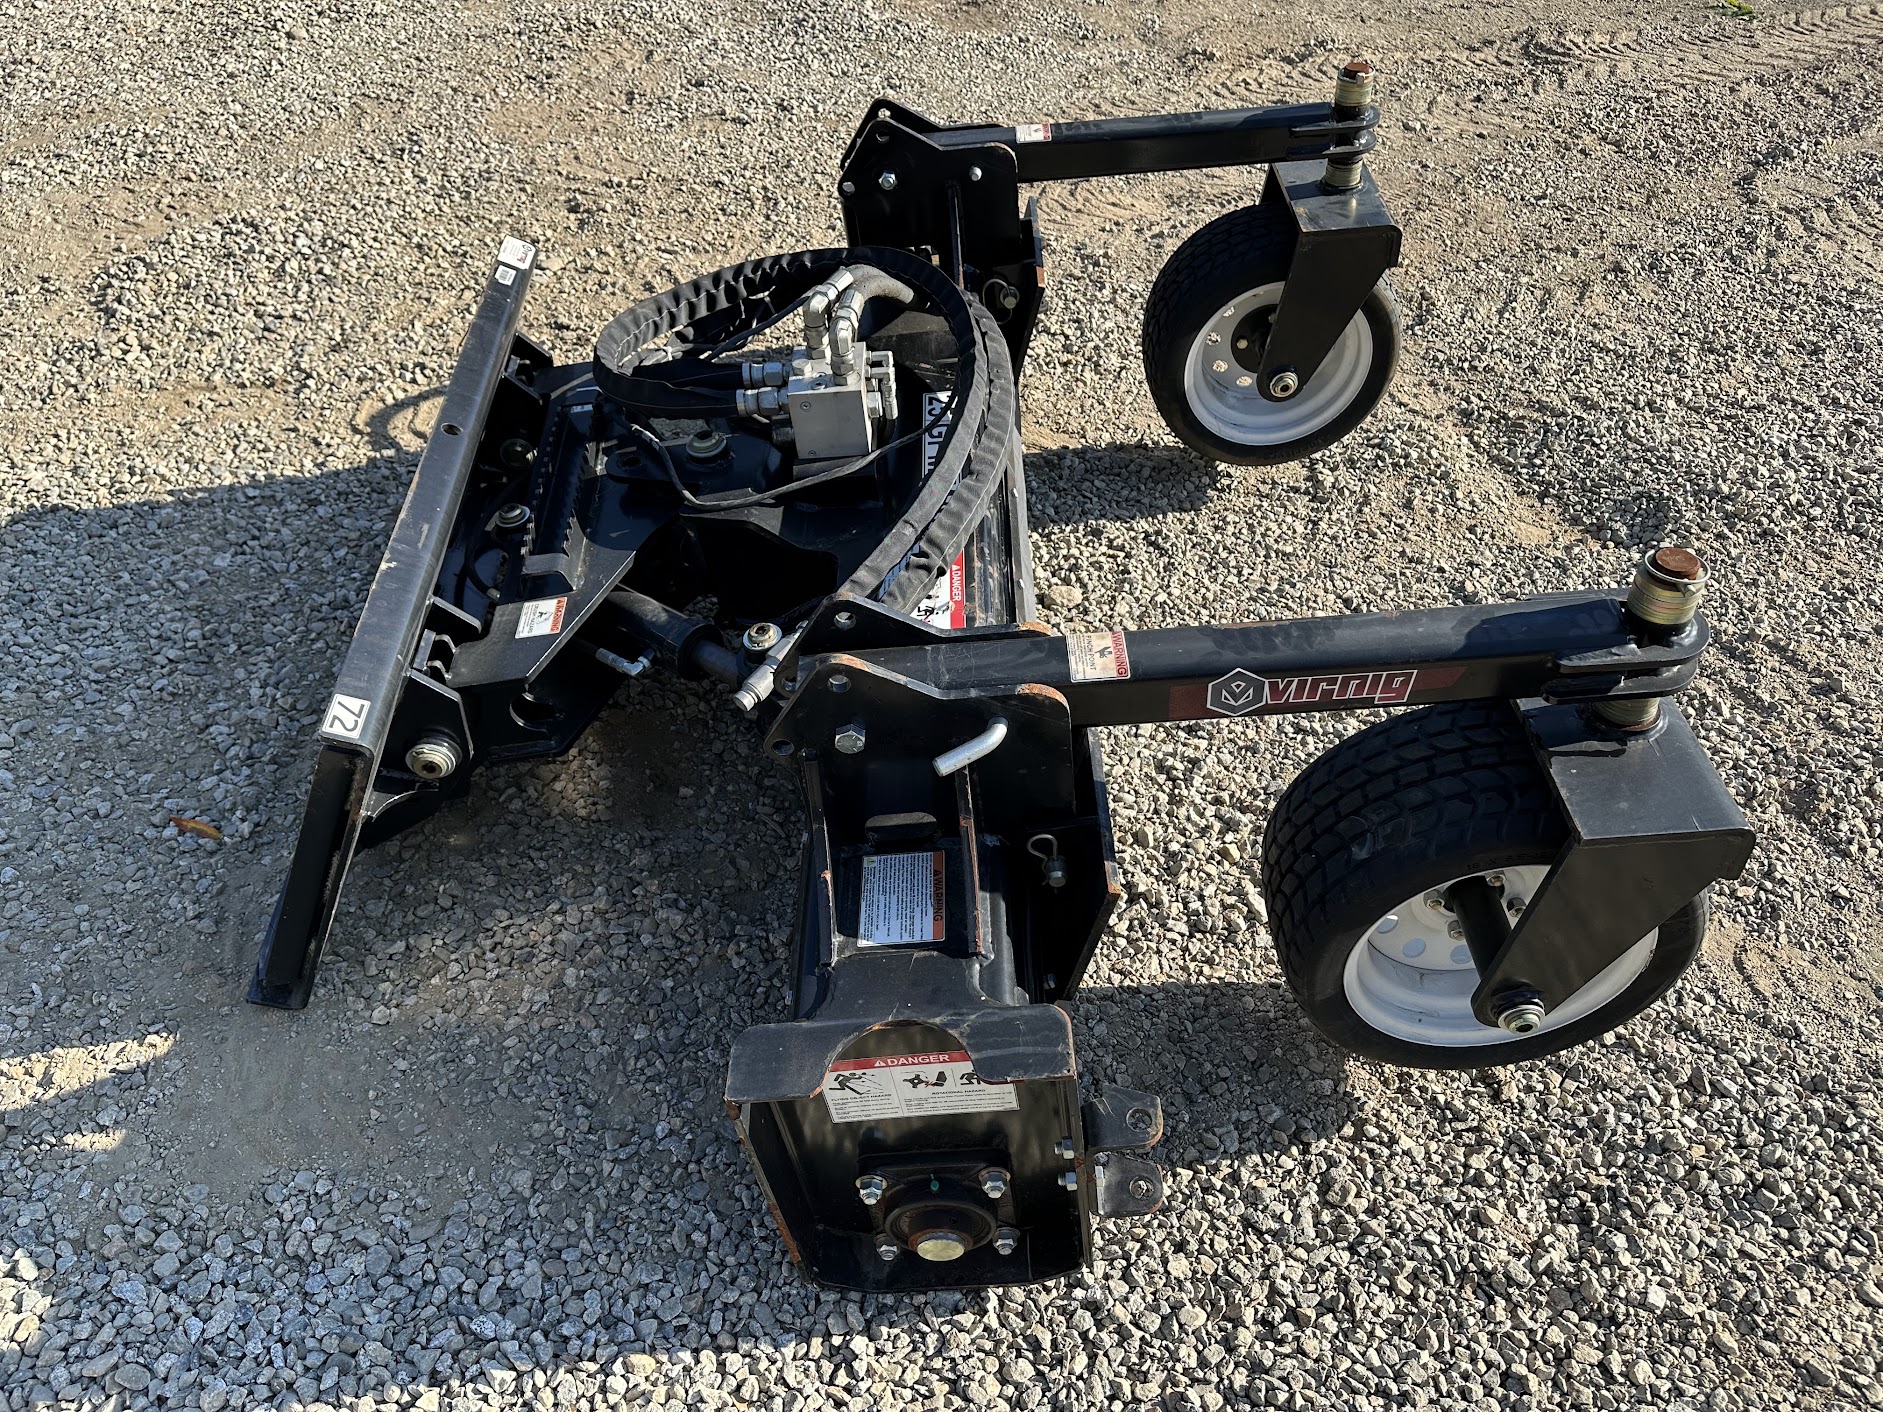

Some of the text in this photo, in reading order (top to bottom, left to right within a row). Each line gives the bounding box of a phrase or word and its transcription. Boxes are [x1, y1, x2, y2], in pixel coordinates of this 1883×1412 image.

[952, 571, 962, 601] DANGER
[551, 603, 565, 631] WARNING
[1085, 635, 1097, 671] PINCH POINT
[1112, 634, 1127, 675] WARNING
[329, 701, 365, 732] 72
[933, 877, 943, 922] WARNING
[887, 1054, 950, 1066] DANGER
